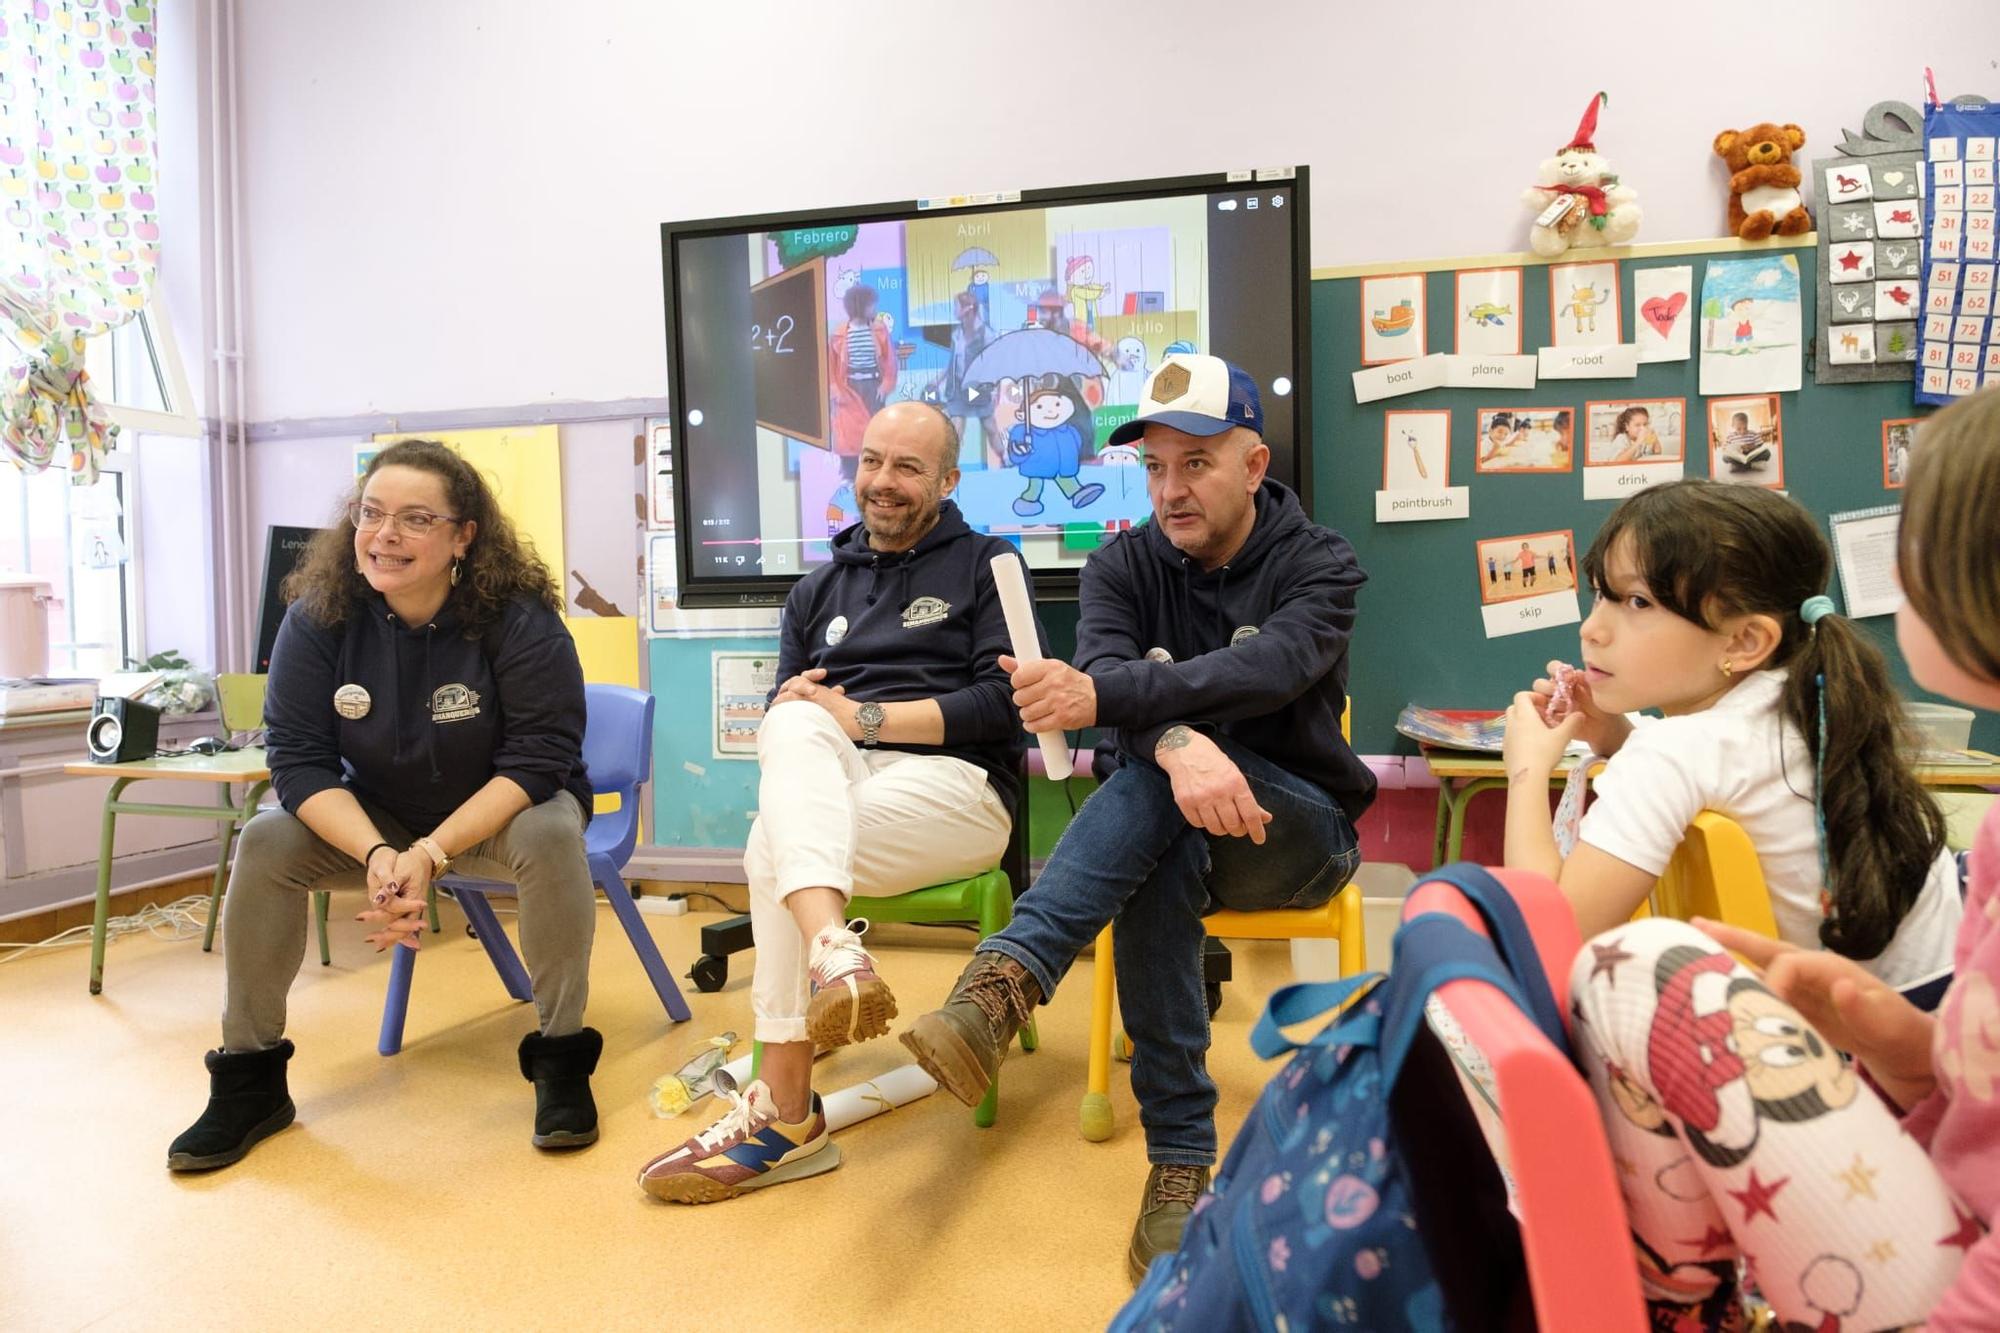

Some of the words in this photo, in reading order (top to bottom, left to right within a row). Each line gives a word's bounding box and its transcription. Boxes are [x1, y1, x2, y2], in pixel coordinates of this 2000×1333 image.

[1976, 143, 1985, 154] 2
[1943, 168, 1954, 178] 11
[1972, 168, 1986, 178] 12
[1906, 184, 1915, 194] 2
[1943, 194, 1956, 204] 21
[1971, 193, 1989, 204] 22
[958, 222, 991, 236] Abril
[1941, 218, 1955, 229] 31
[1971, 218, 1989, 230] 32
[794, 230, 849, 245] Febrero
[1865, 228, 1874, 238] 6
[1939, 240, 1953, 251] 41
[1971, 241, 1989, 252] 42
[878, 276, 904, 290] Mar
[1937, 270, 1952, 281] 51
[1970, 271, 1988, 283] 52
[1015, 282, 1050, 297] May
[1934, 296, 1947, 307] 61
[1967, 297, 1985, 309] 62
[1128, 321, 1163, 335] Julio
[1932, 321, 1944, 333] 71
[1961, 324, 1978, 336] 72
[1571, 354, 1604, 366] robot
[1929, 350, 1942, 361] 81
[1957, 352, 1974, 364] 82
[1990, 353, 2000, 365] 8
[1472, 364, 1505, 376] plane
[1386, 371, 1414, 384] boat
[1929, 376, 1942, 387] 91
[1955, 378, 1971, 390] 92
[1617, 473, 1648, 486] drink
[1391, 496, 1453, 511] paintbrush
[281, 538, 314, 550] Leno
[1519, 605, 1542, 620] skip
